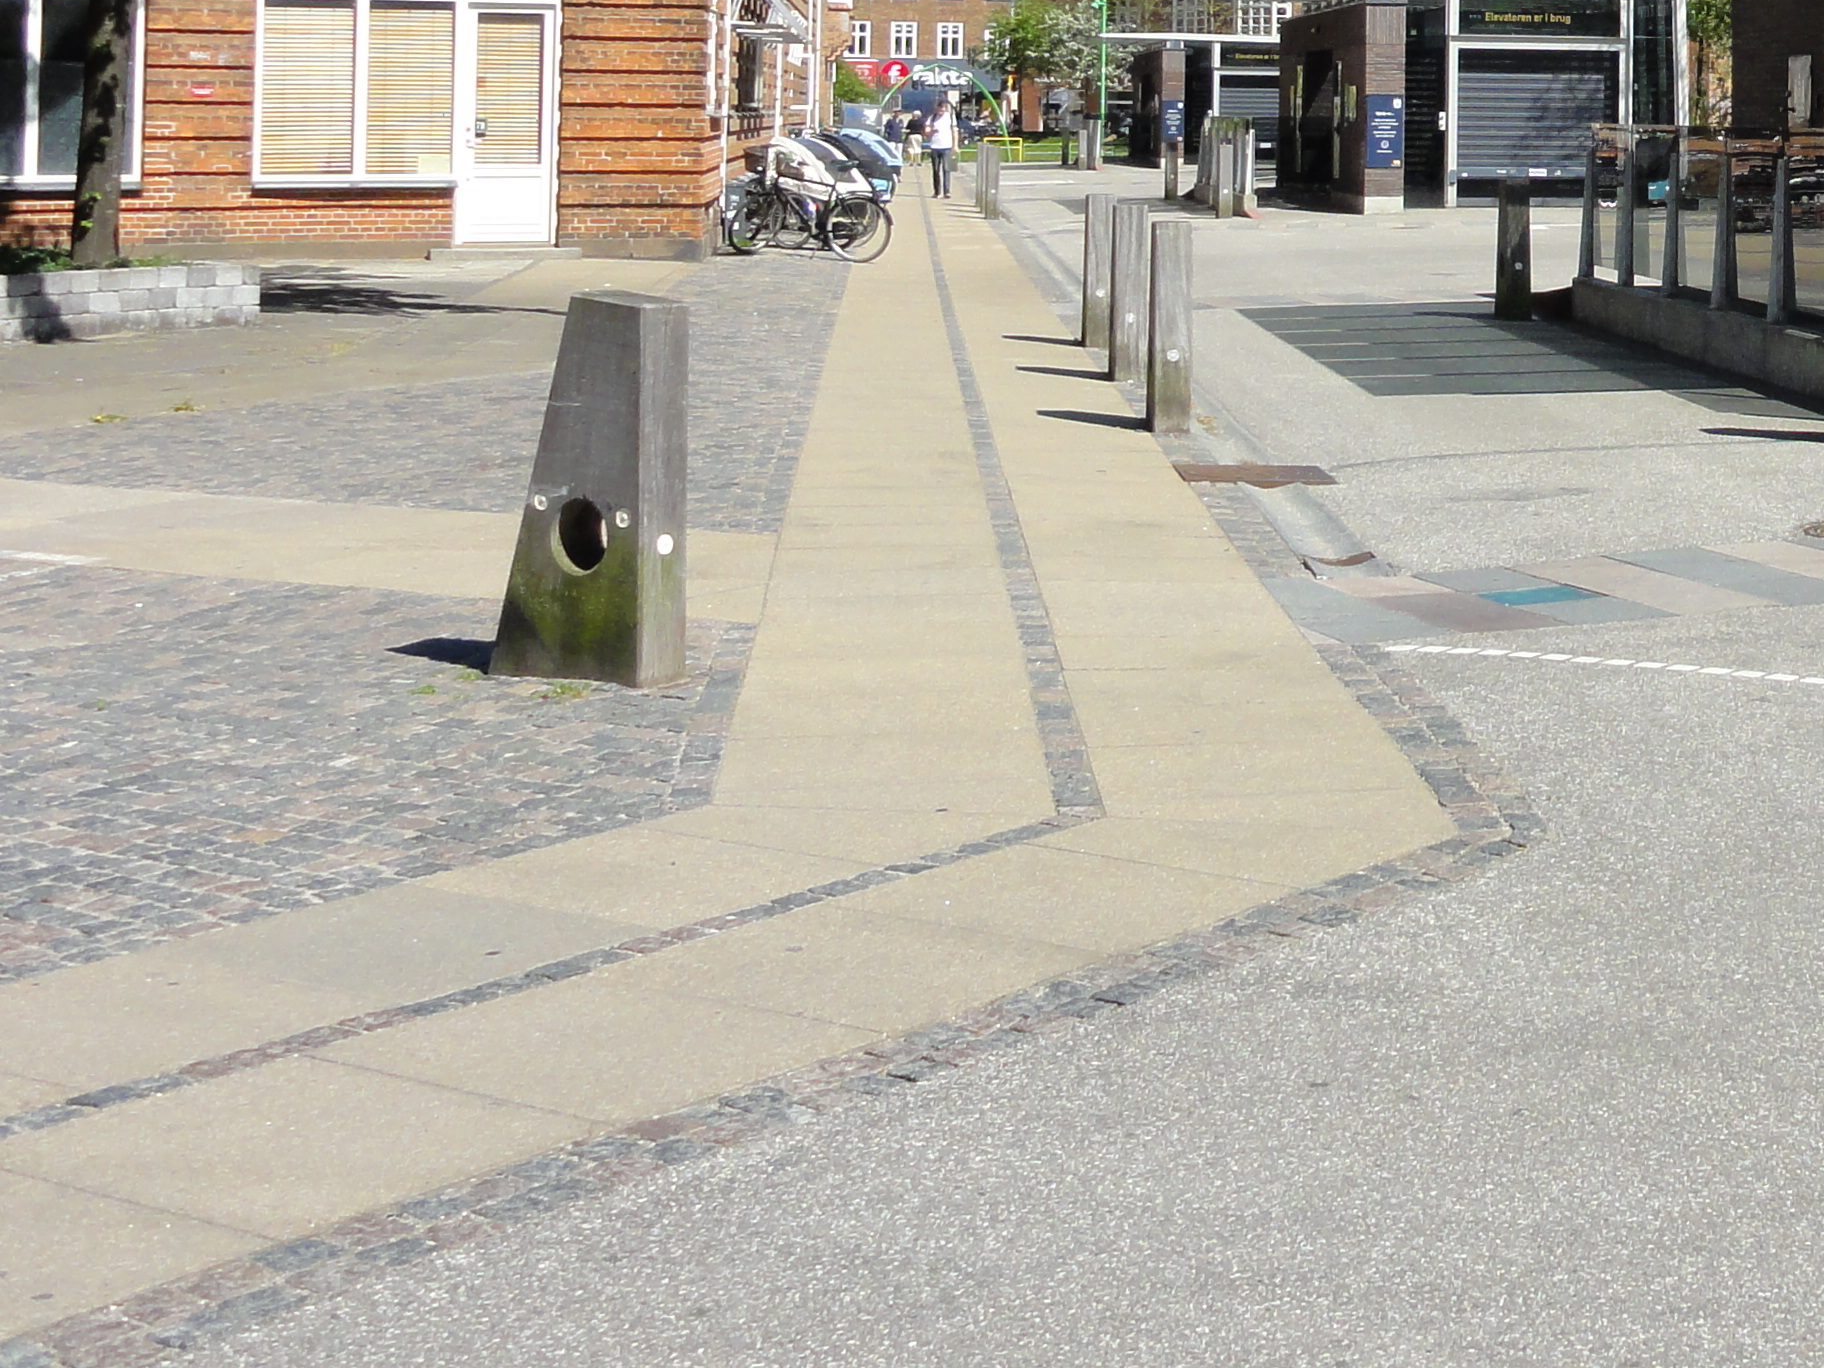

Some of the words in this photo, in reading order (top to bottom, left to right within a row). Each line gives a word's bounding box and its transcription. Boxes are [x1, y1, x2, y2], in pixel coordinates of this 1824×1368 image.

[1484, 12, 1532, 22] Elevatoren
[1533, 14, 1543, 23] er
[1549, 13, 1572, 25] brug
[912, 64, 974, 86] fakta
